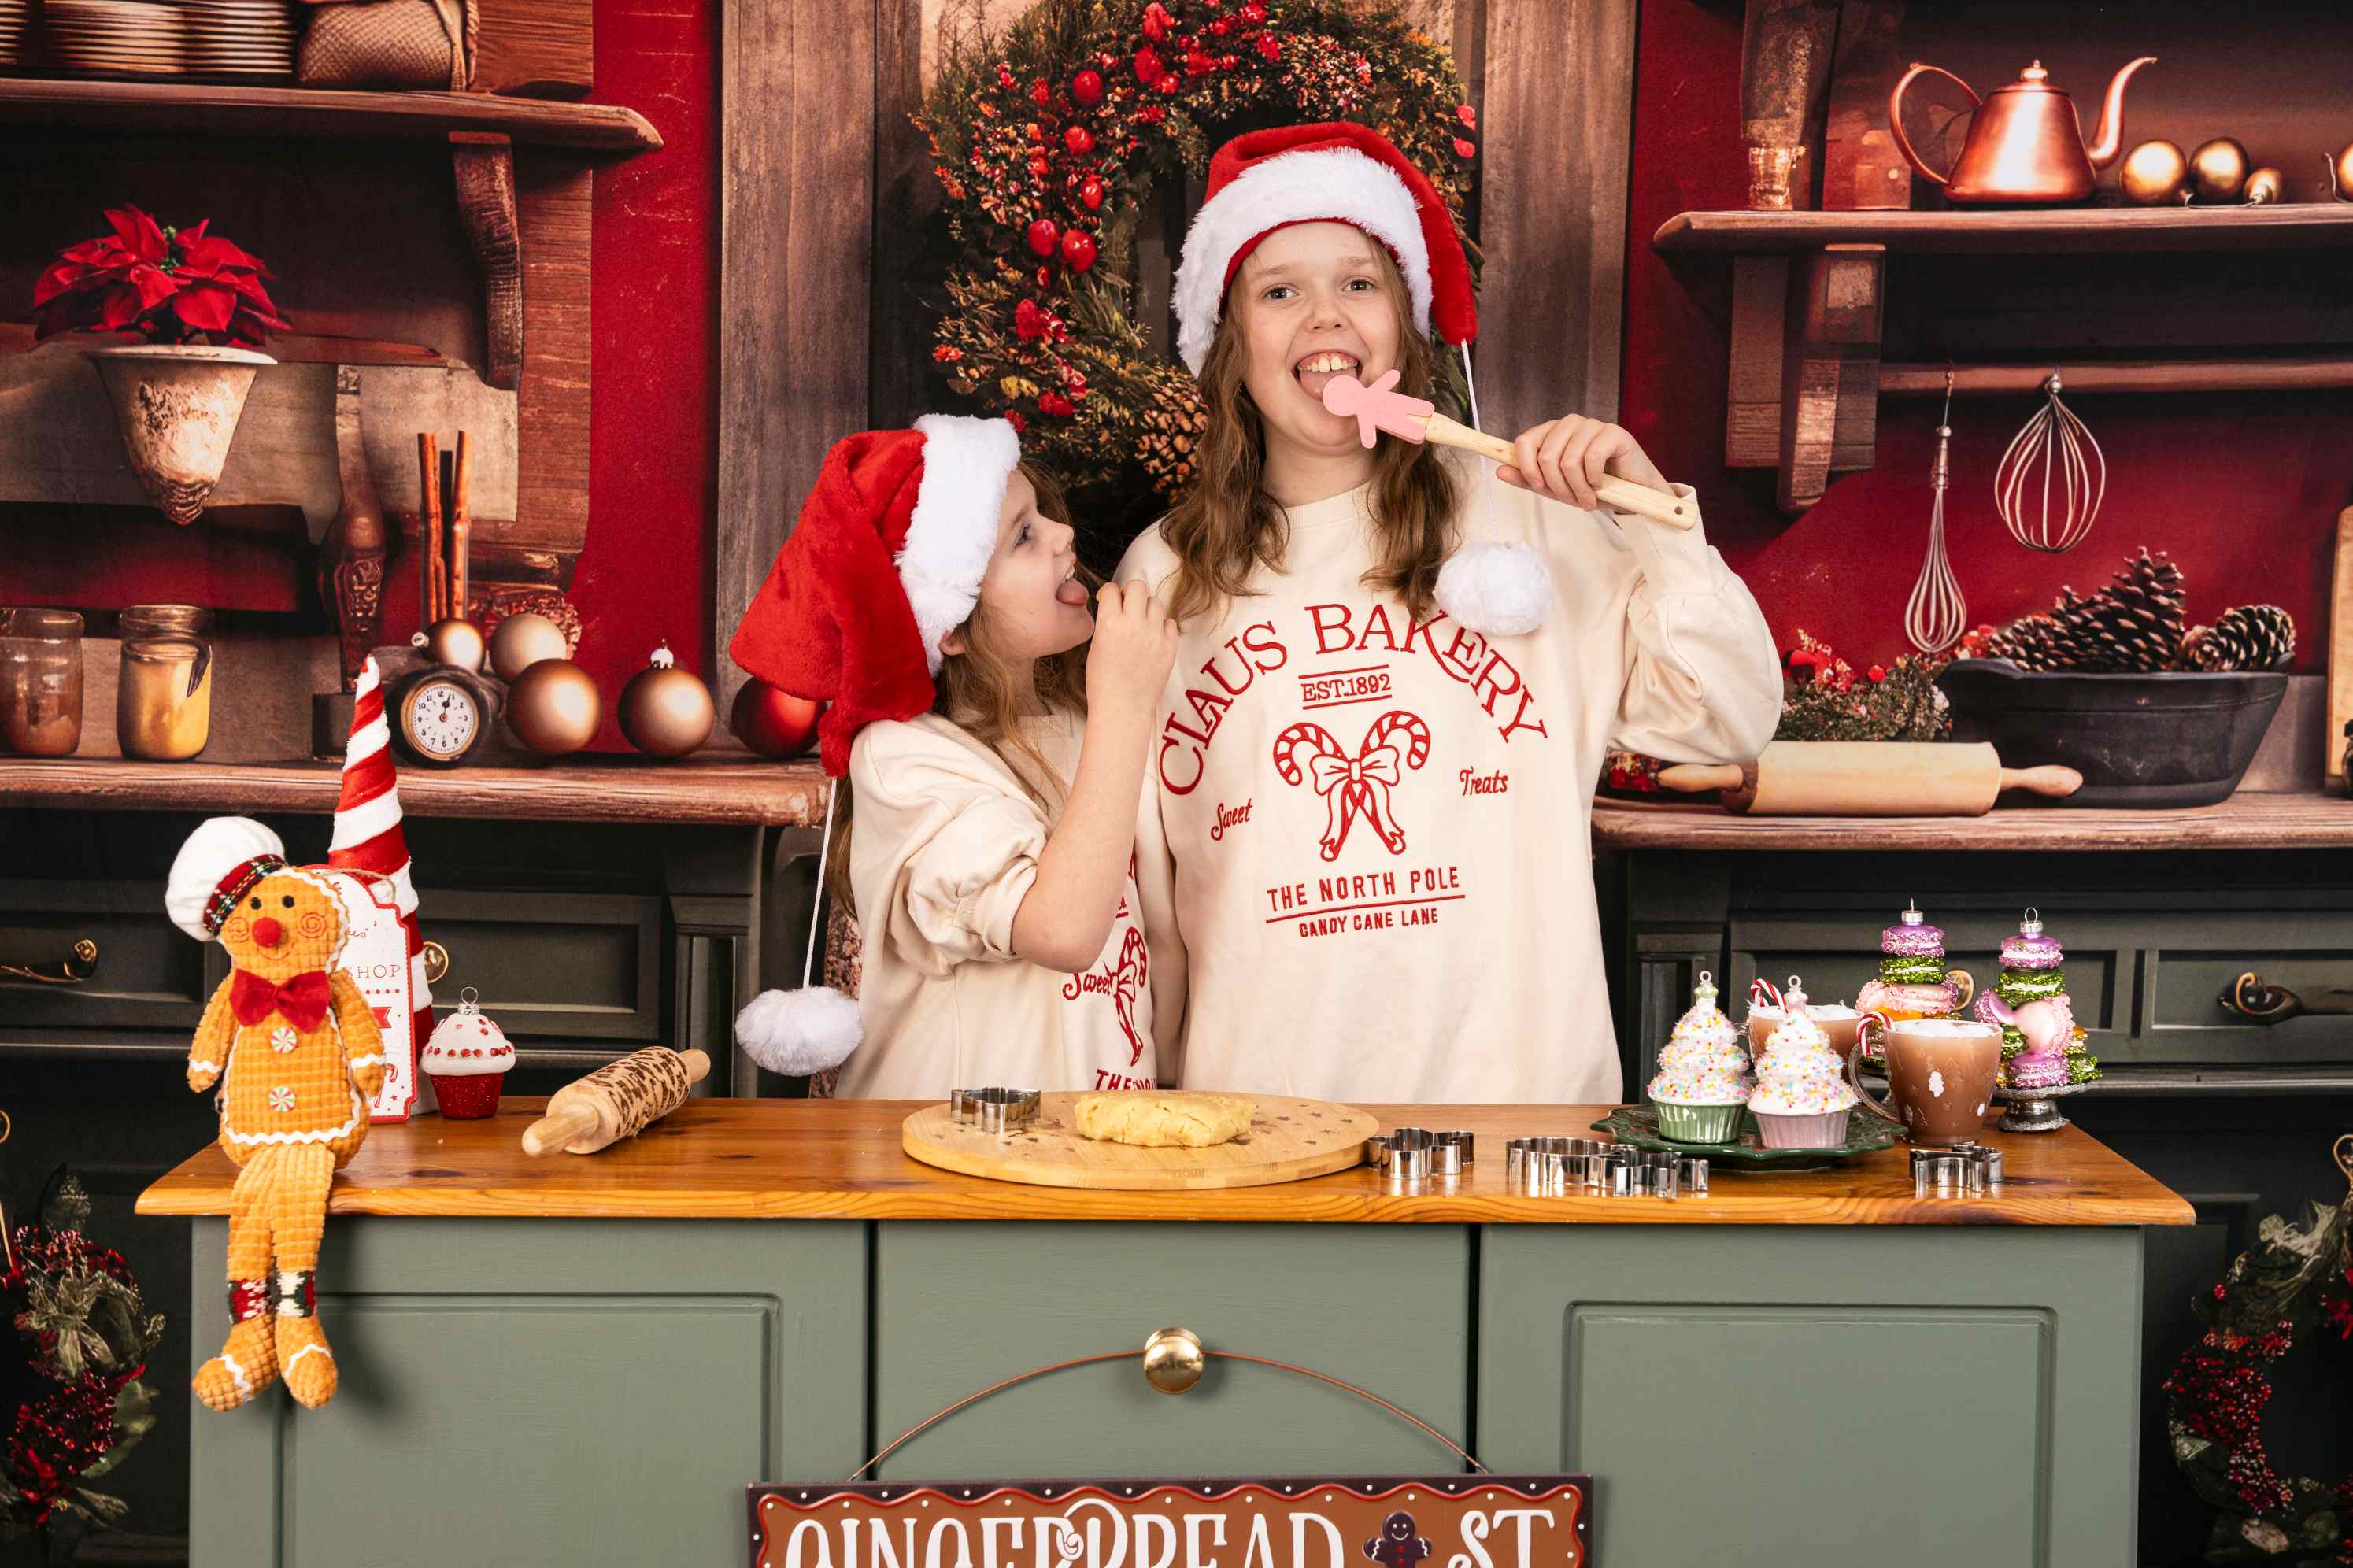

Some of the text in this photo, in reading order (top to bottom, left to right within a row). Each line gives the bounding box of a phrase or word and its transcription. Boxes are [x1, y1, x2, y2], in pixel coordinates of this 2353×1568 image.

[1158, 604, 1548, 797] CLAUS BAKERY
[1300, 673, 1392, 702] EST.1892
[1459, 767, 1509, 796] Treats
[1210, 798, 1253, 842] Sweet
[1266, 866, 1460, 912] THE NORTH POLE
[1298, 908, 1438, 937] CANDY CANE LANE
